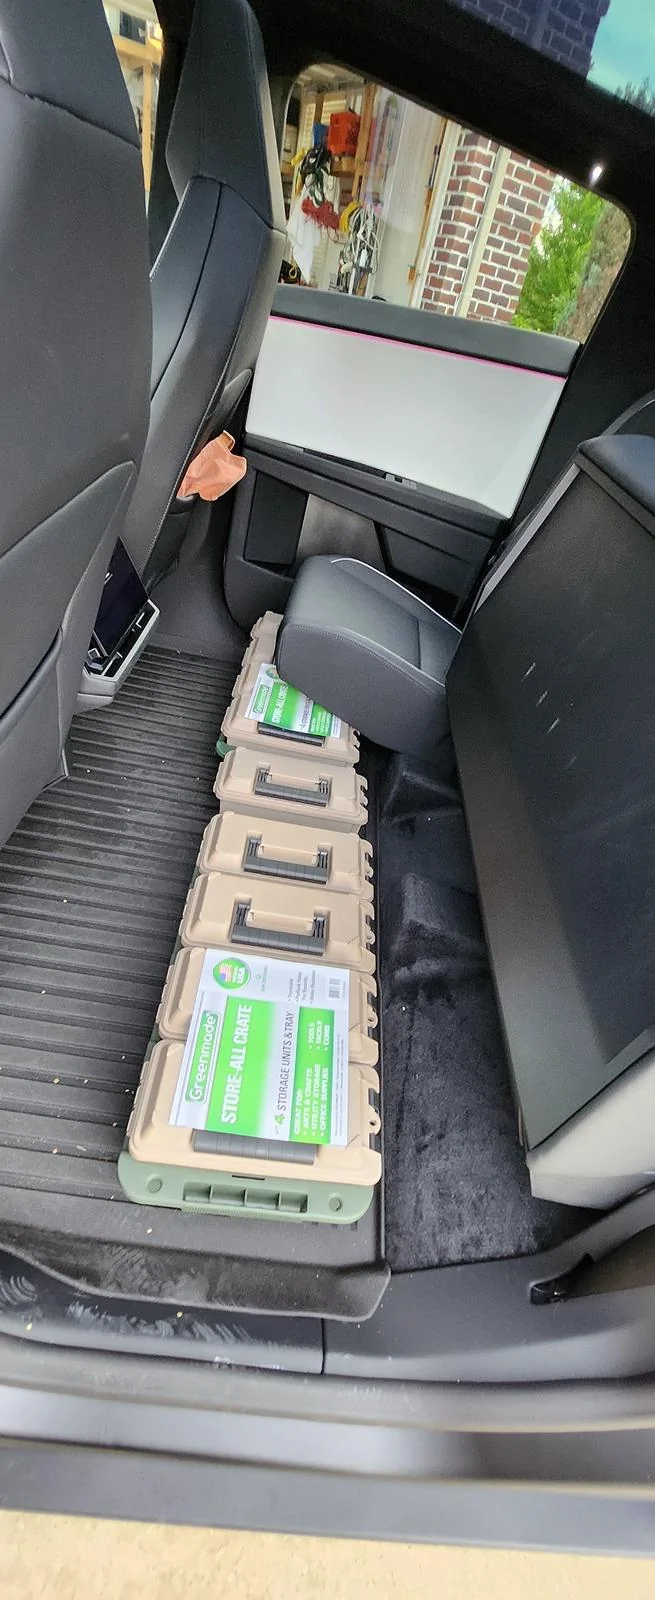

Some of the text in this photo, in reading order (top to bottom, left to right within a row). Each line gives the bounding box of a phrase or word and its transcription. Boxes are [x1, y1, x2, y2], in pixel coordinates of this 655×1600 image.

[188, 1015, 216, 1100] Greenmade
[221, 1004, 252, 1124] STORE-ALL CRATE
[283, 1041, 292, 1067] UNITS
[277, 1067, 290, 1111] STORAGE
[274, 1113, 286, 1126] 4
